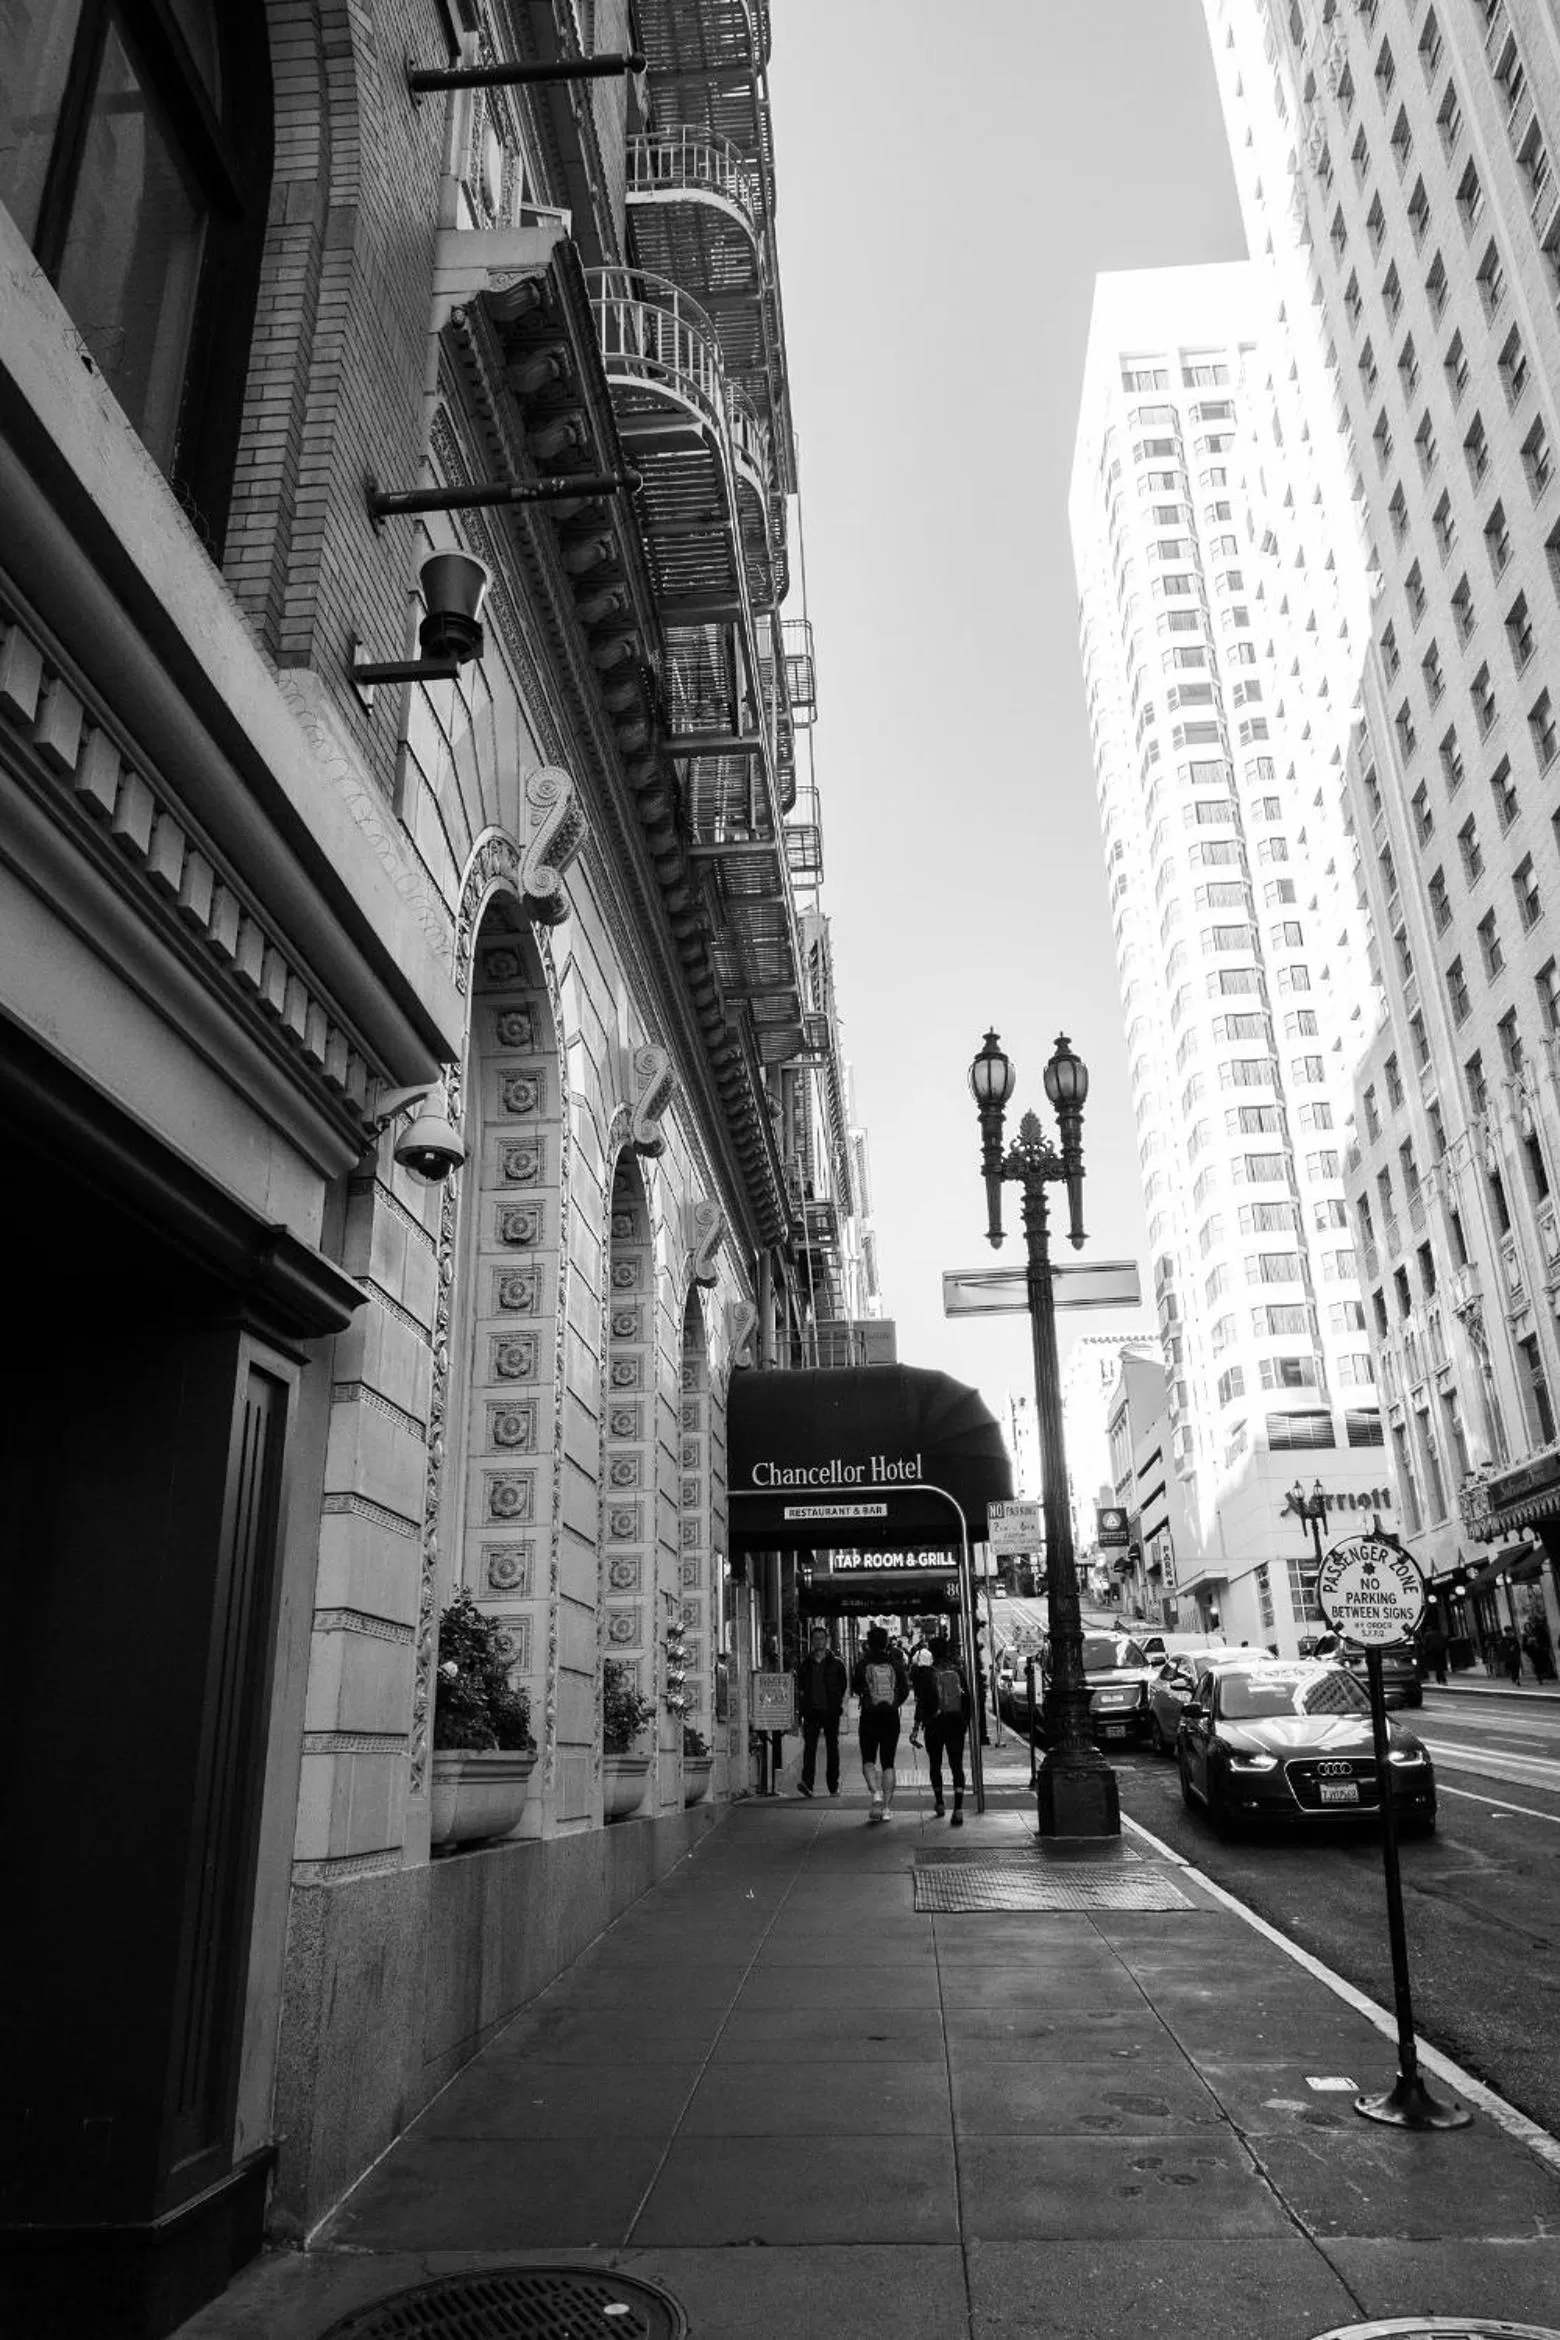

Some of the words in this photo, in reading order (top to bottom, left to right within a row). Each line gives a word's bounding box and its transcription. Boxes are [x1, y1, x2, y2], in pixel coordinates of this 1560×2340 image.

[752, 1460, 865, 1486] Chancellor
[870, 1453, 923, 1482] Hotel
[788, 1507, 851, 1517] RESTAURANT
[853, 1507, 860, 1515] &
[862, 1506, 882, 1515] BAR
[989, 1504, 1003, 1518] NO
[836, 1553, 861, 1568] TAP
[864, 1552, 904, 1567] ROOM
[906, 1553, 917, 1567] &
[918, 1551, 957, 1567] GRILL
[1323, 1545, 1389, 1594] PASSENGER
[1389, 1557, 1419, 1595] ZONE
[1360, 1578, 1380, 1590] NO
[1345, 1592, 1397, 1605] PARKING
[1331, 1606, 1380, 1619] BETWEEN
[1383, 1607, 1414, 1620] SIGNS
